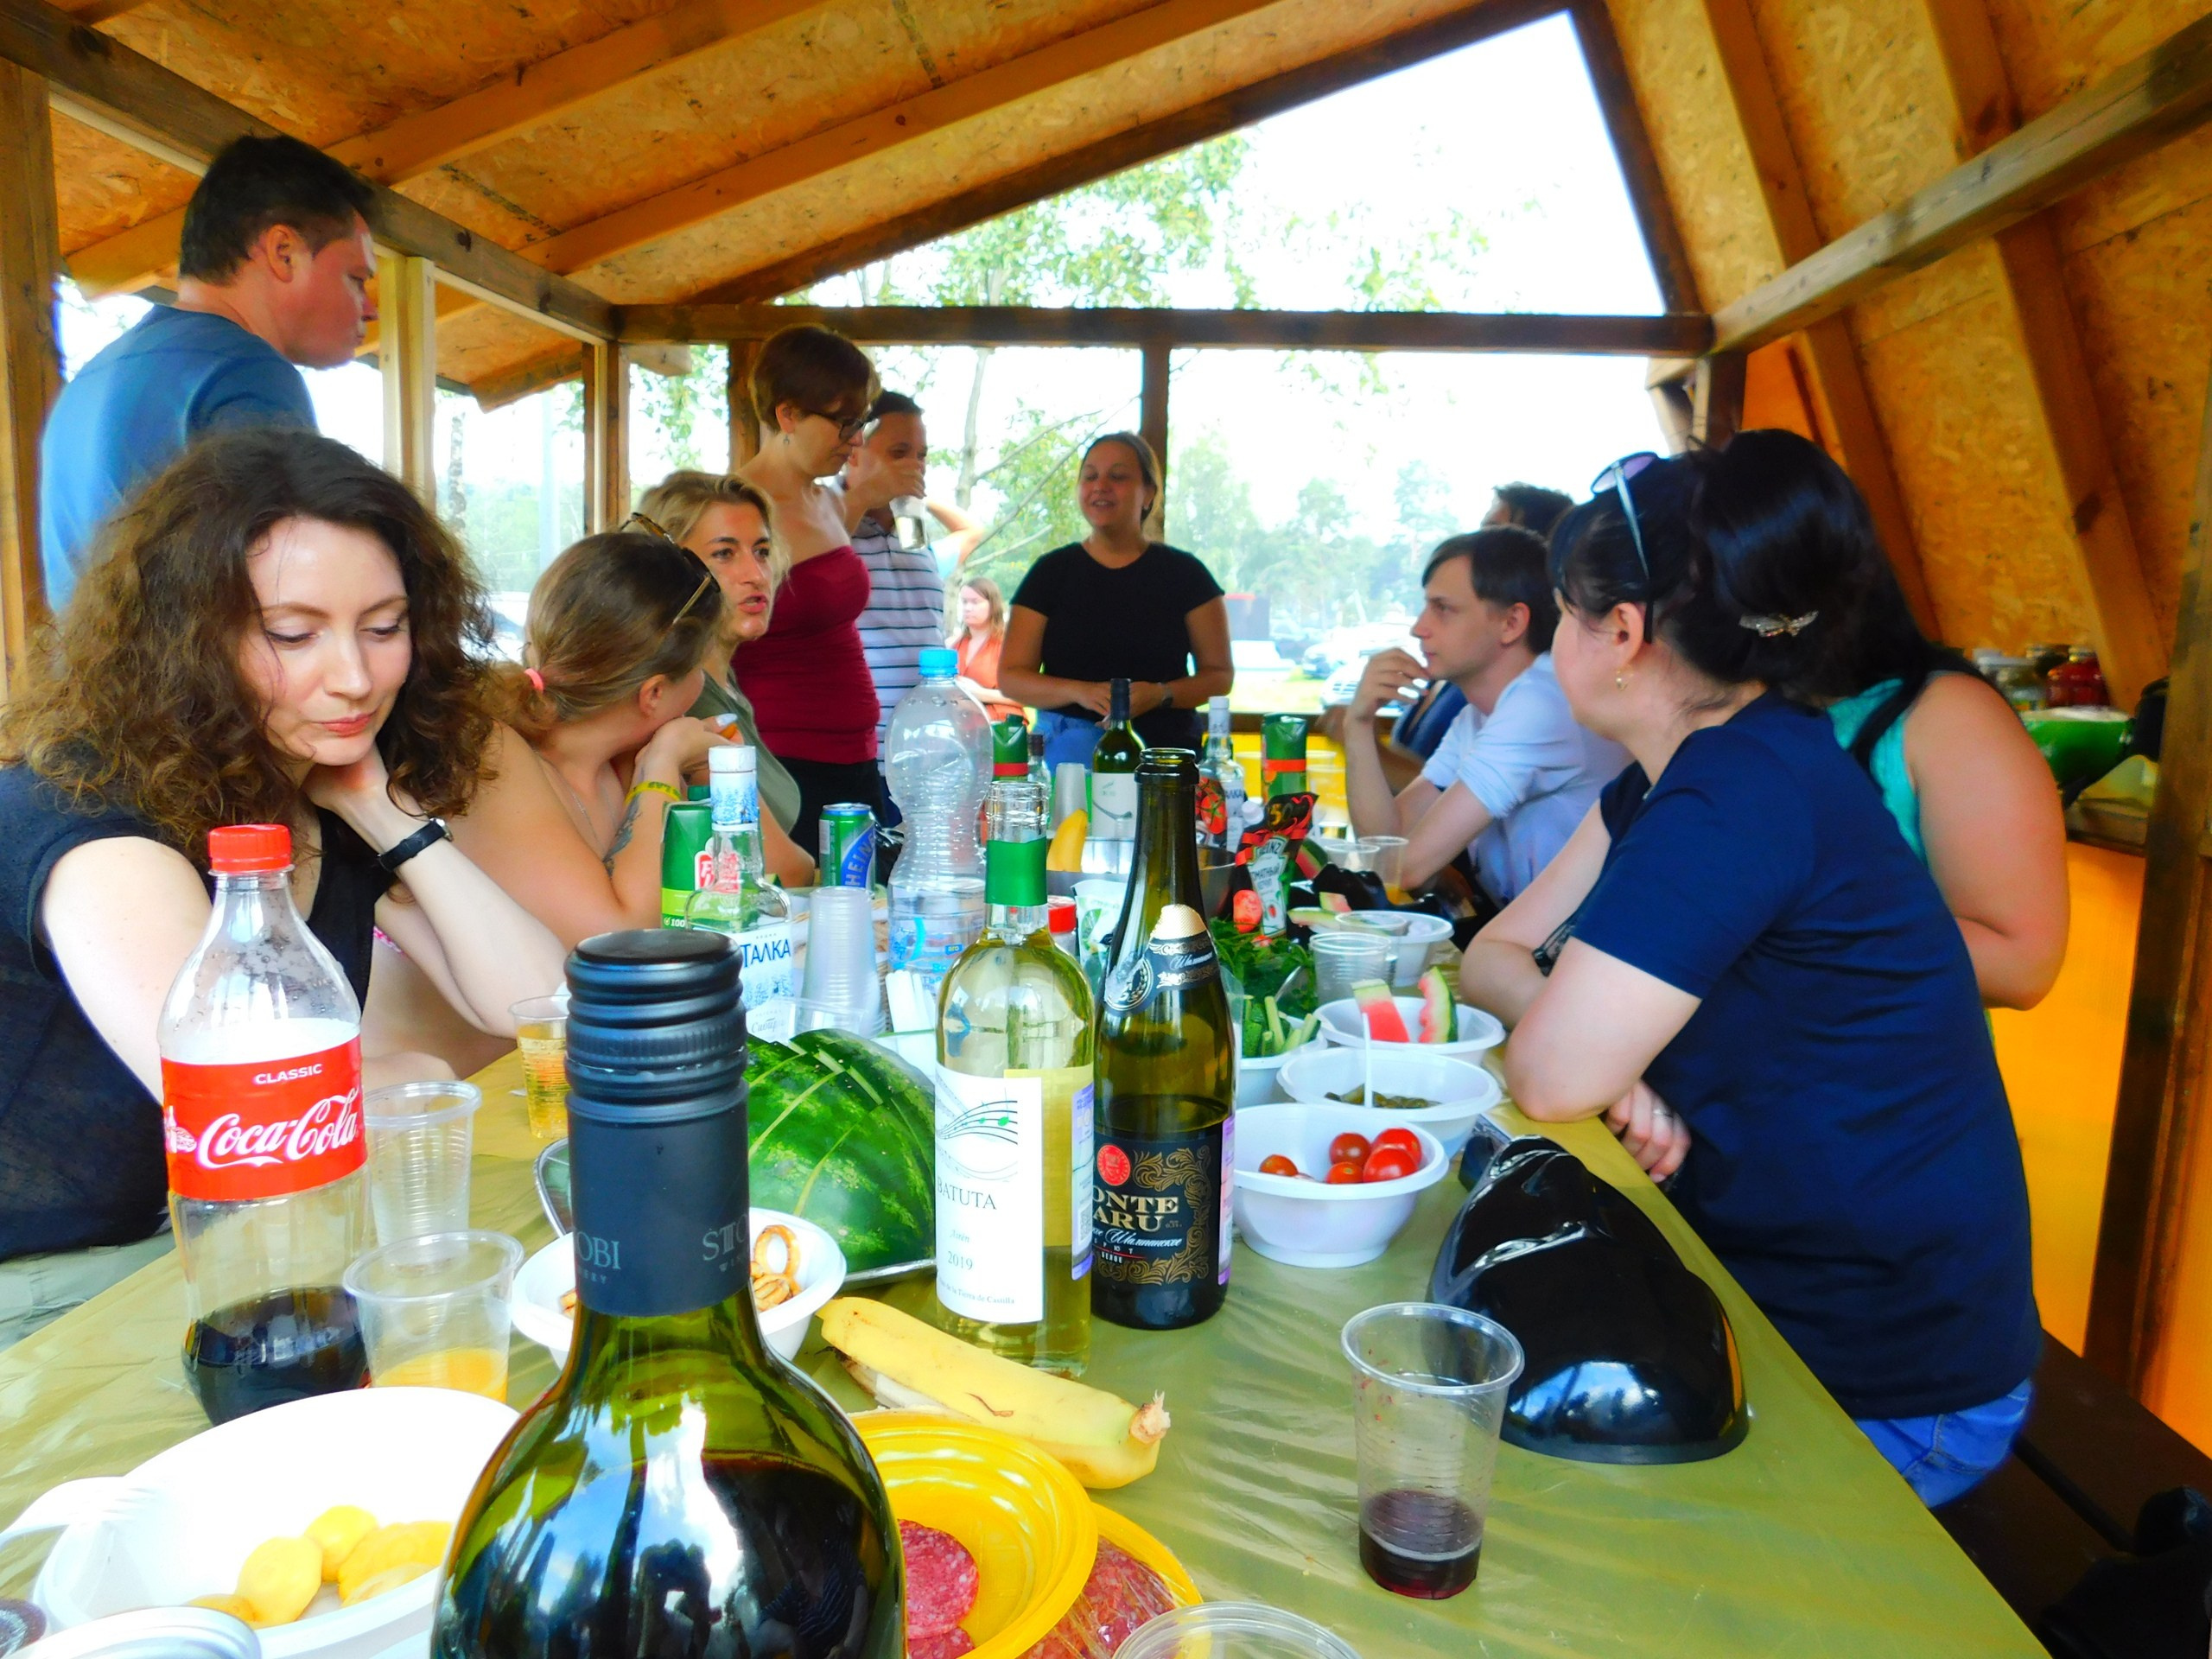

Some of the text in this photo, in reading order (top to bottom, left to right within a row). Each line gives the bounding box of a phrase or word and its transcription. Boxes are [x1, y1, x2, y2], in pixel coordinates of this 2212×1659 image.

[740, 938, 791, 968] ТАЛКА
[254, 1064, 322, 1085] CLASSIC
[197, 1087, 359, 1168] Coca-Cola
[937, 1176, 997, 1211] BATUTA
[1093, 1185, 1179, 1214] ONTE
[1093, 1205, 1165, 1233] ARU
[576, 1230, 621, 1269] OBI
[948, 1250, 973, 1271] 2019
